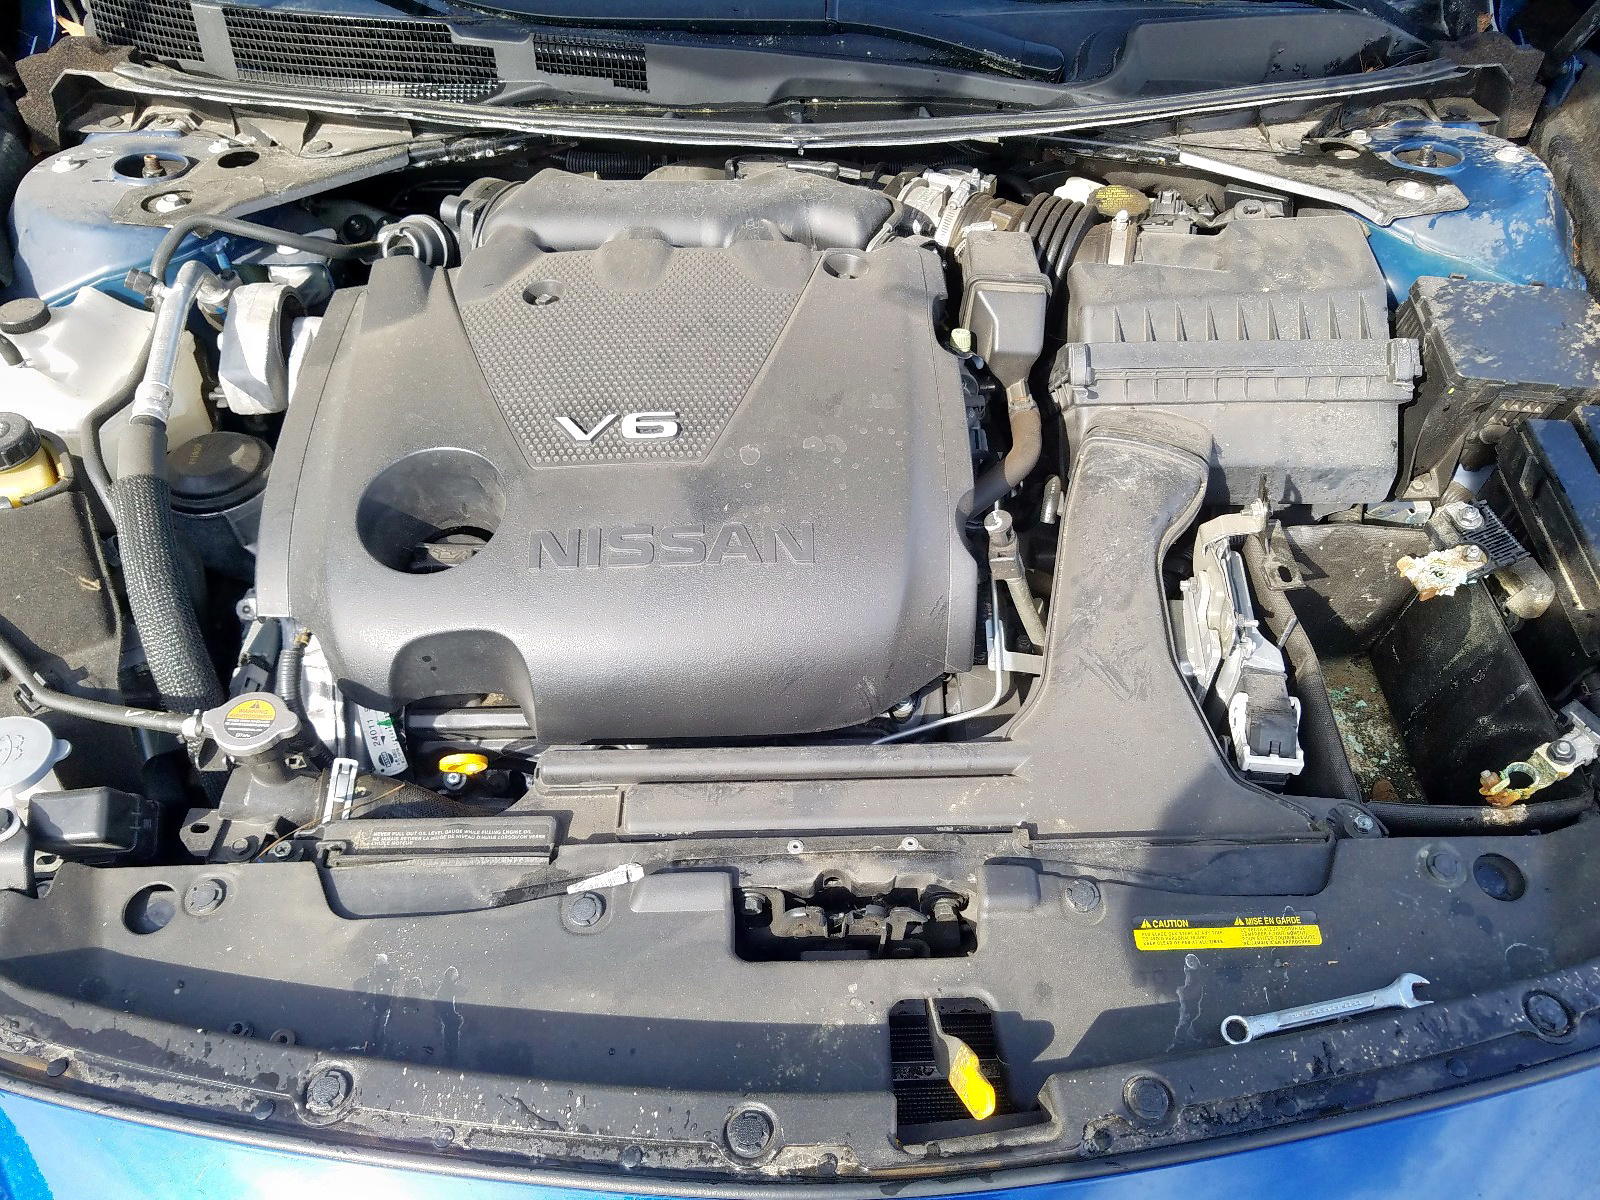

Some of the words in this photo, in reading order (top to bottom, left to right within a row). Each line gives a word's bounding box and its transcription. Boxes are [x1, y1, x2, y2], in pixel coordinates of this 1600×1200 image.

[555, 411, 683, 443] V6
[528, 520, 816, 570] NISSAN
[366, 719, 381, 747] 24011
[1152, 919, 1189, 928] CAUTION
[1244, 917, 1264, 926] MISE
[1264, 916, 1275, 925] EN
[1275, 916, 1301, 925] GARDE
